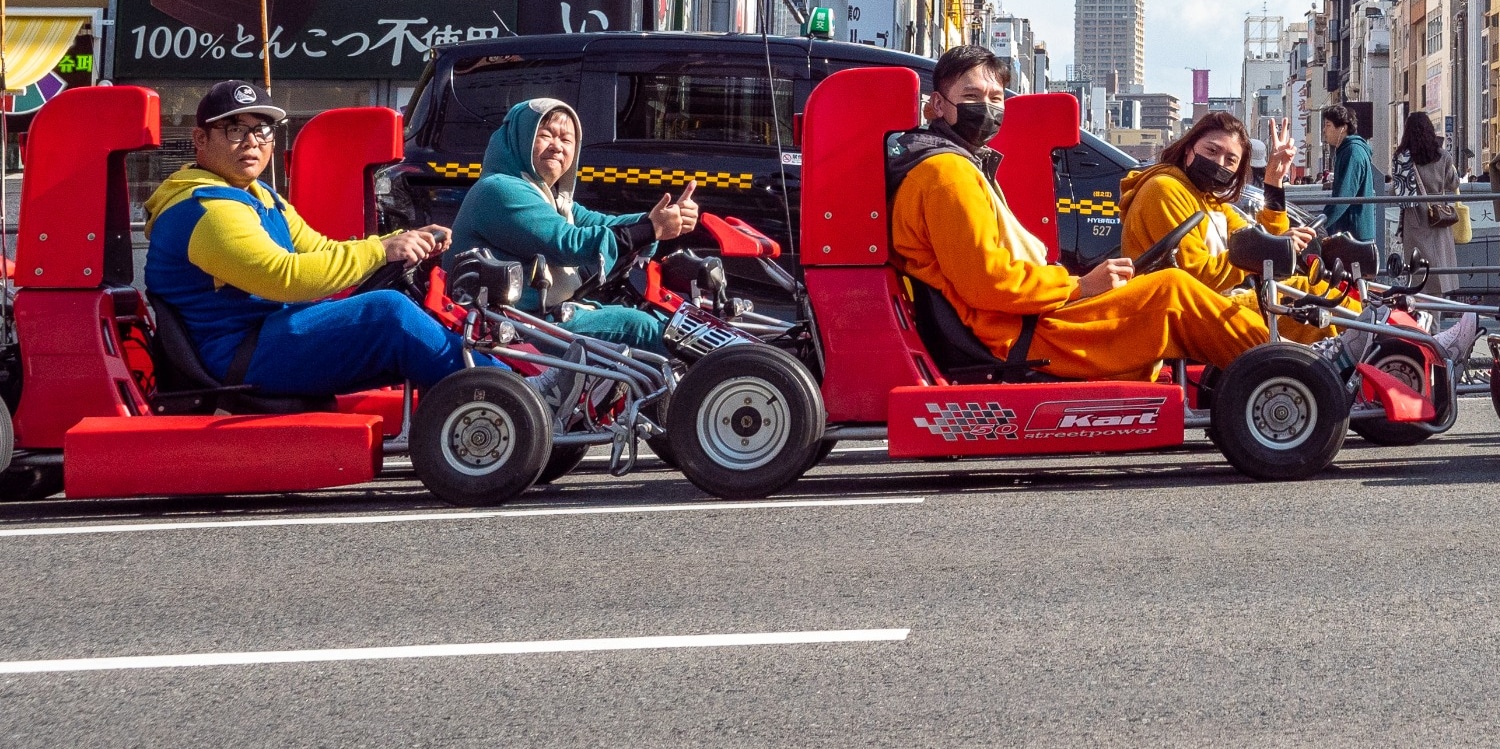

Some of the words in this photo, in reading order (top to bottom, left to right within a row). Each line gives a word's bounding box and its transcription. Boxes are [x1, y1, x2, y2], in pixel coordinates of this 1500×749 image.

[58, 54, 93, 73] 슈퍼
[1092, 225, 1112, 236] 527
[1060, 412, 1158, 428] Kart
[969, 423, 1019, 436] 50
[1024, 427, 1158, 439] streetpower
